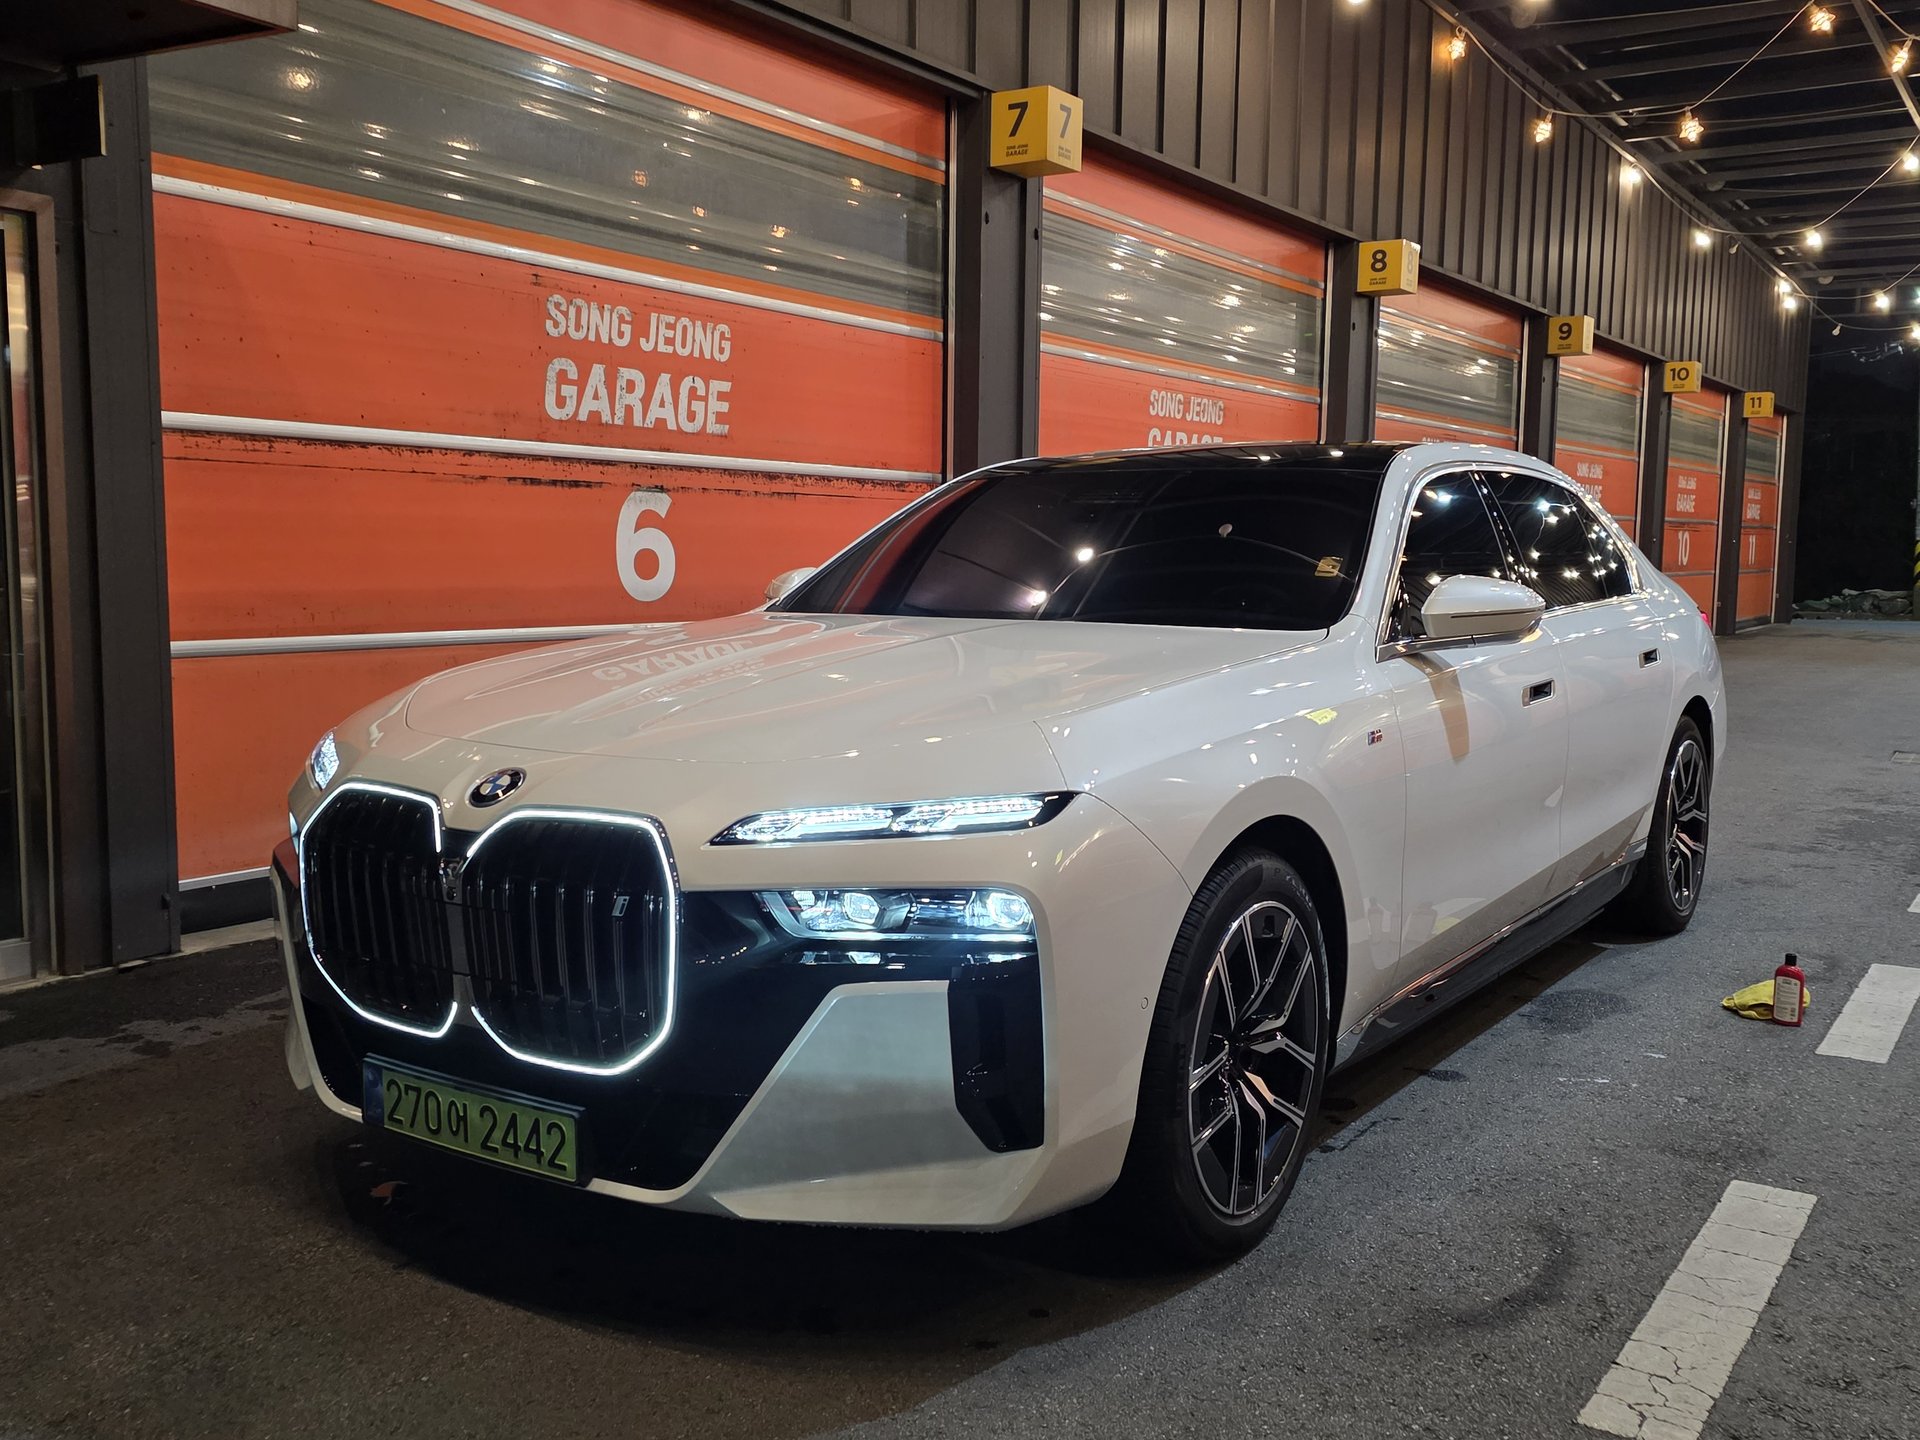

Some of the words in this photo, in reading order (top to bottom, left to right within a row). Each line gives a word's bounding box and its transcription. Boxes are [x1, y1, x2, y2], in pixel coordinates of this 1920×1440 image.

[1008, 101, 1029, 138] 7
[1059, 103, 1072, 139] 7
[1006, 149, 1028, 157] GARAGE
[1370, 249, 1388, 272] 8
[545, 293, 632, 347] SONG
[639, 312, 731, 362] JEONG
[1558, 322, 1573, 341] 9
[1669, 367, 1690, 381] 10
[544, 357, 732, 435] GARAGE
[1149, 389, 1184, 419] SONG
[1186, 396, 1224, 425] JEONG
[1749, 396, 1762, 409] 11
[615, 487, 676, 602] 6
[1678, 530, 1690, 567] 10
[1748, 534, 1756, 566] 11
[386, 1078, 470, 1145] 270어
[479, 1103, 569, 1173] 2442
